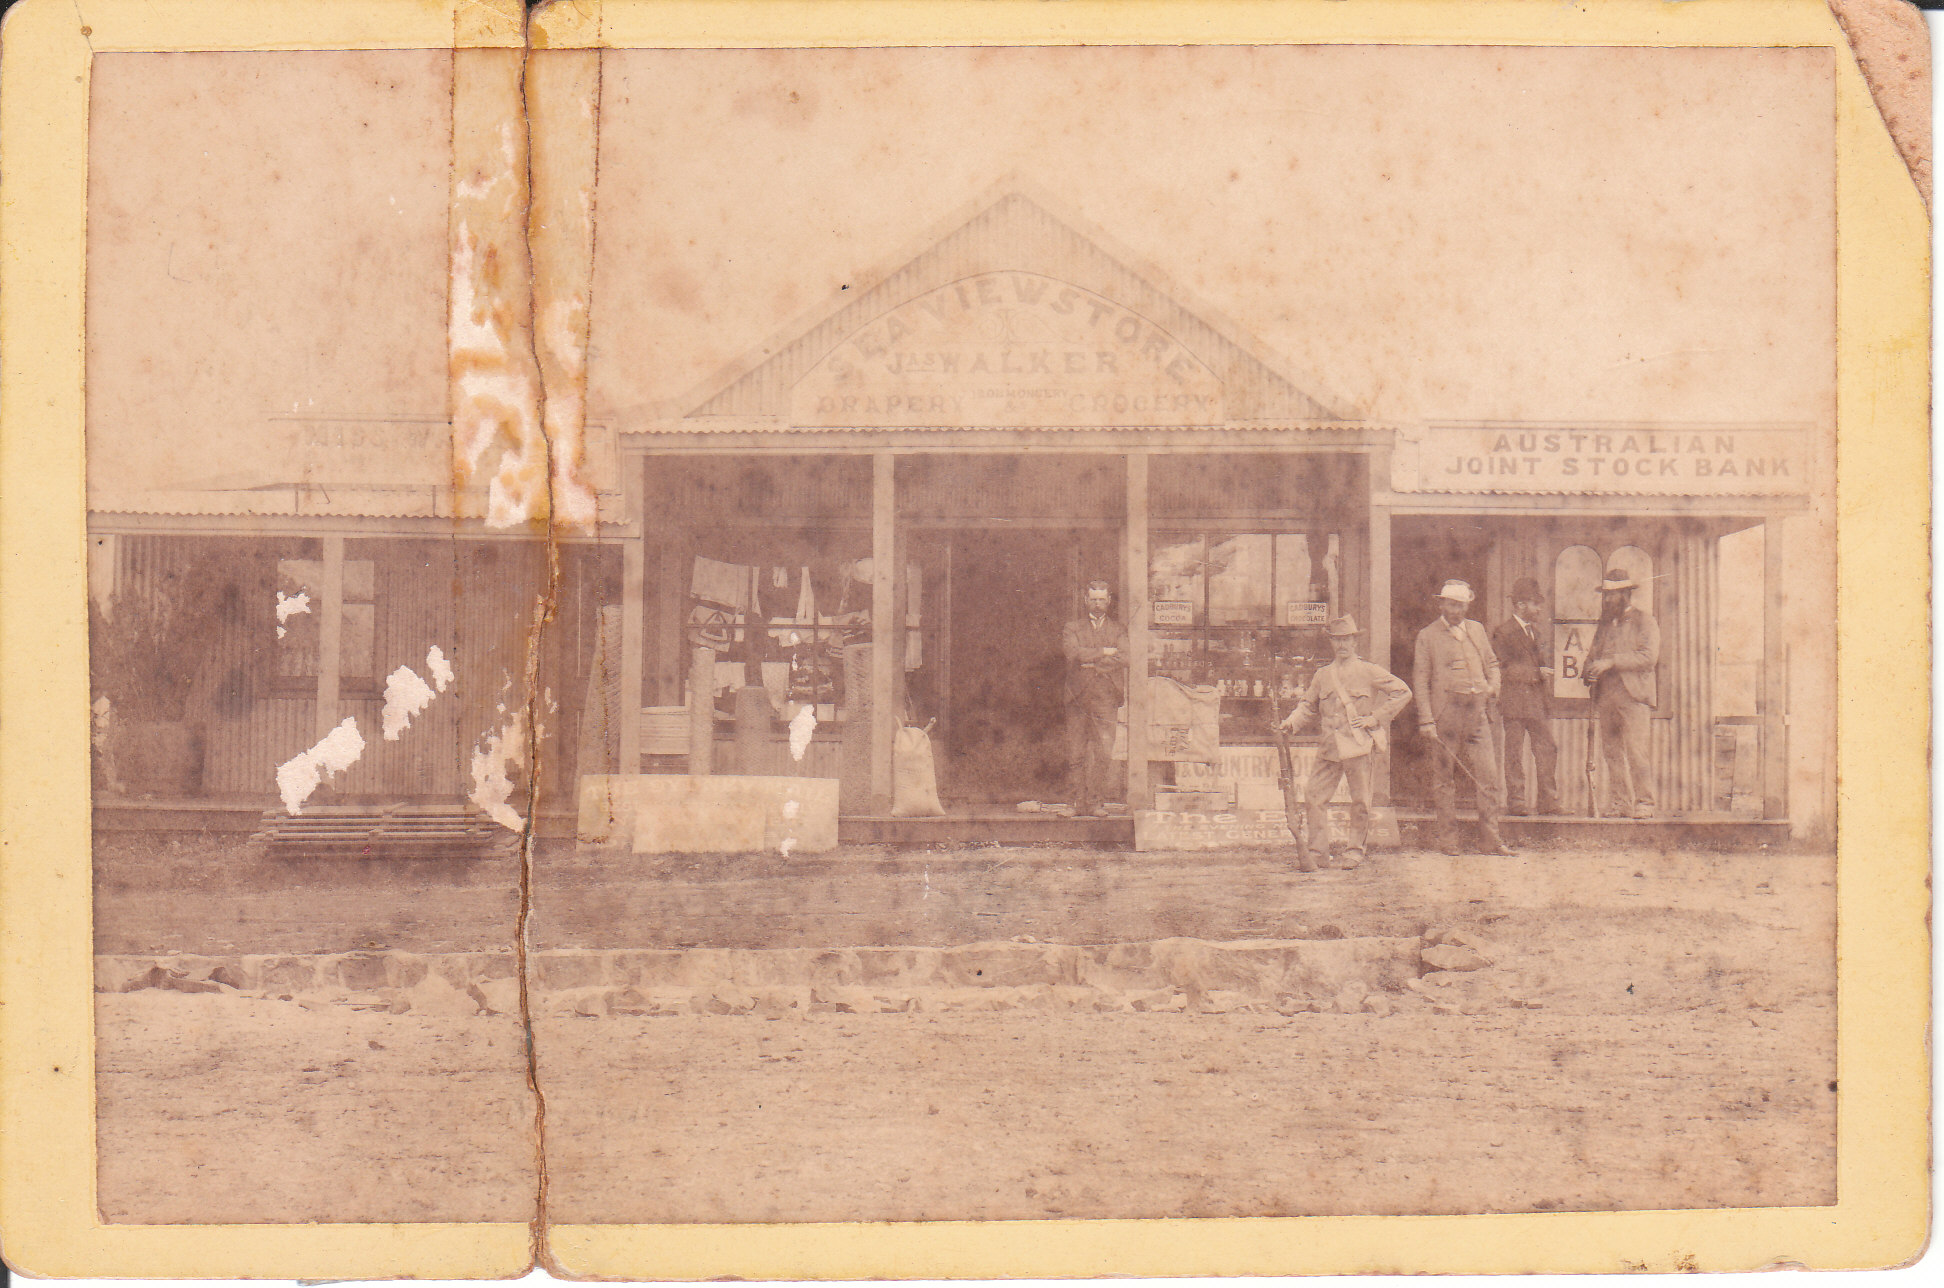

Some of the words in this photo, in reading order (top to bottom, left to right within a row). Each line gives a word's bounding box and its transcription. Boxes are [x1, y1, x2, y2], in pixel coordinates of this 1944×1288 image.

[827, 315, 915, 382] SEA
[919, 275, 1049, 322] VIEW
[1050, 288, 1200, 385] STORE
[939, 351, 1119, 374] WALKER
[816, 394, 963, 414] DRAPERY
[1493, 433, 1736, 453] AUSTRALIAN
[1445, 457, 1541, 476] JOINT
[1561, 457, 1678, 477] STOCK
[1694, 458, 1790, 477] BANK
[1193, 755, 1272, 778] COUNTRY
[1145, 811, 1238, 825] The
[1144, 830, 1216, 841] LATEST
